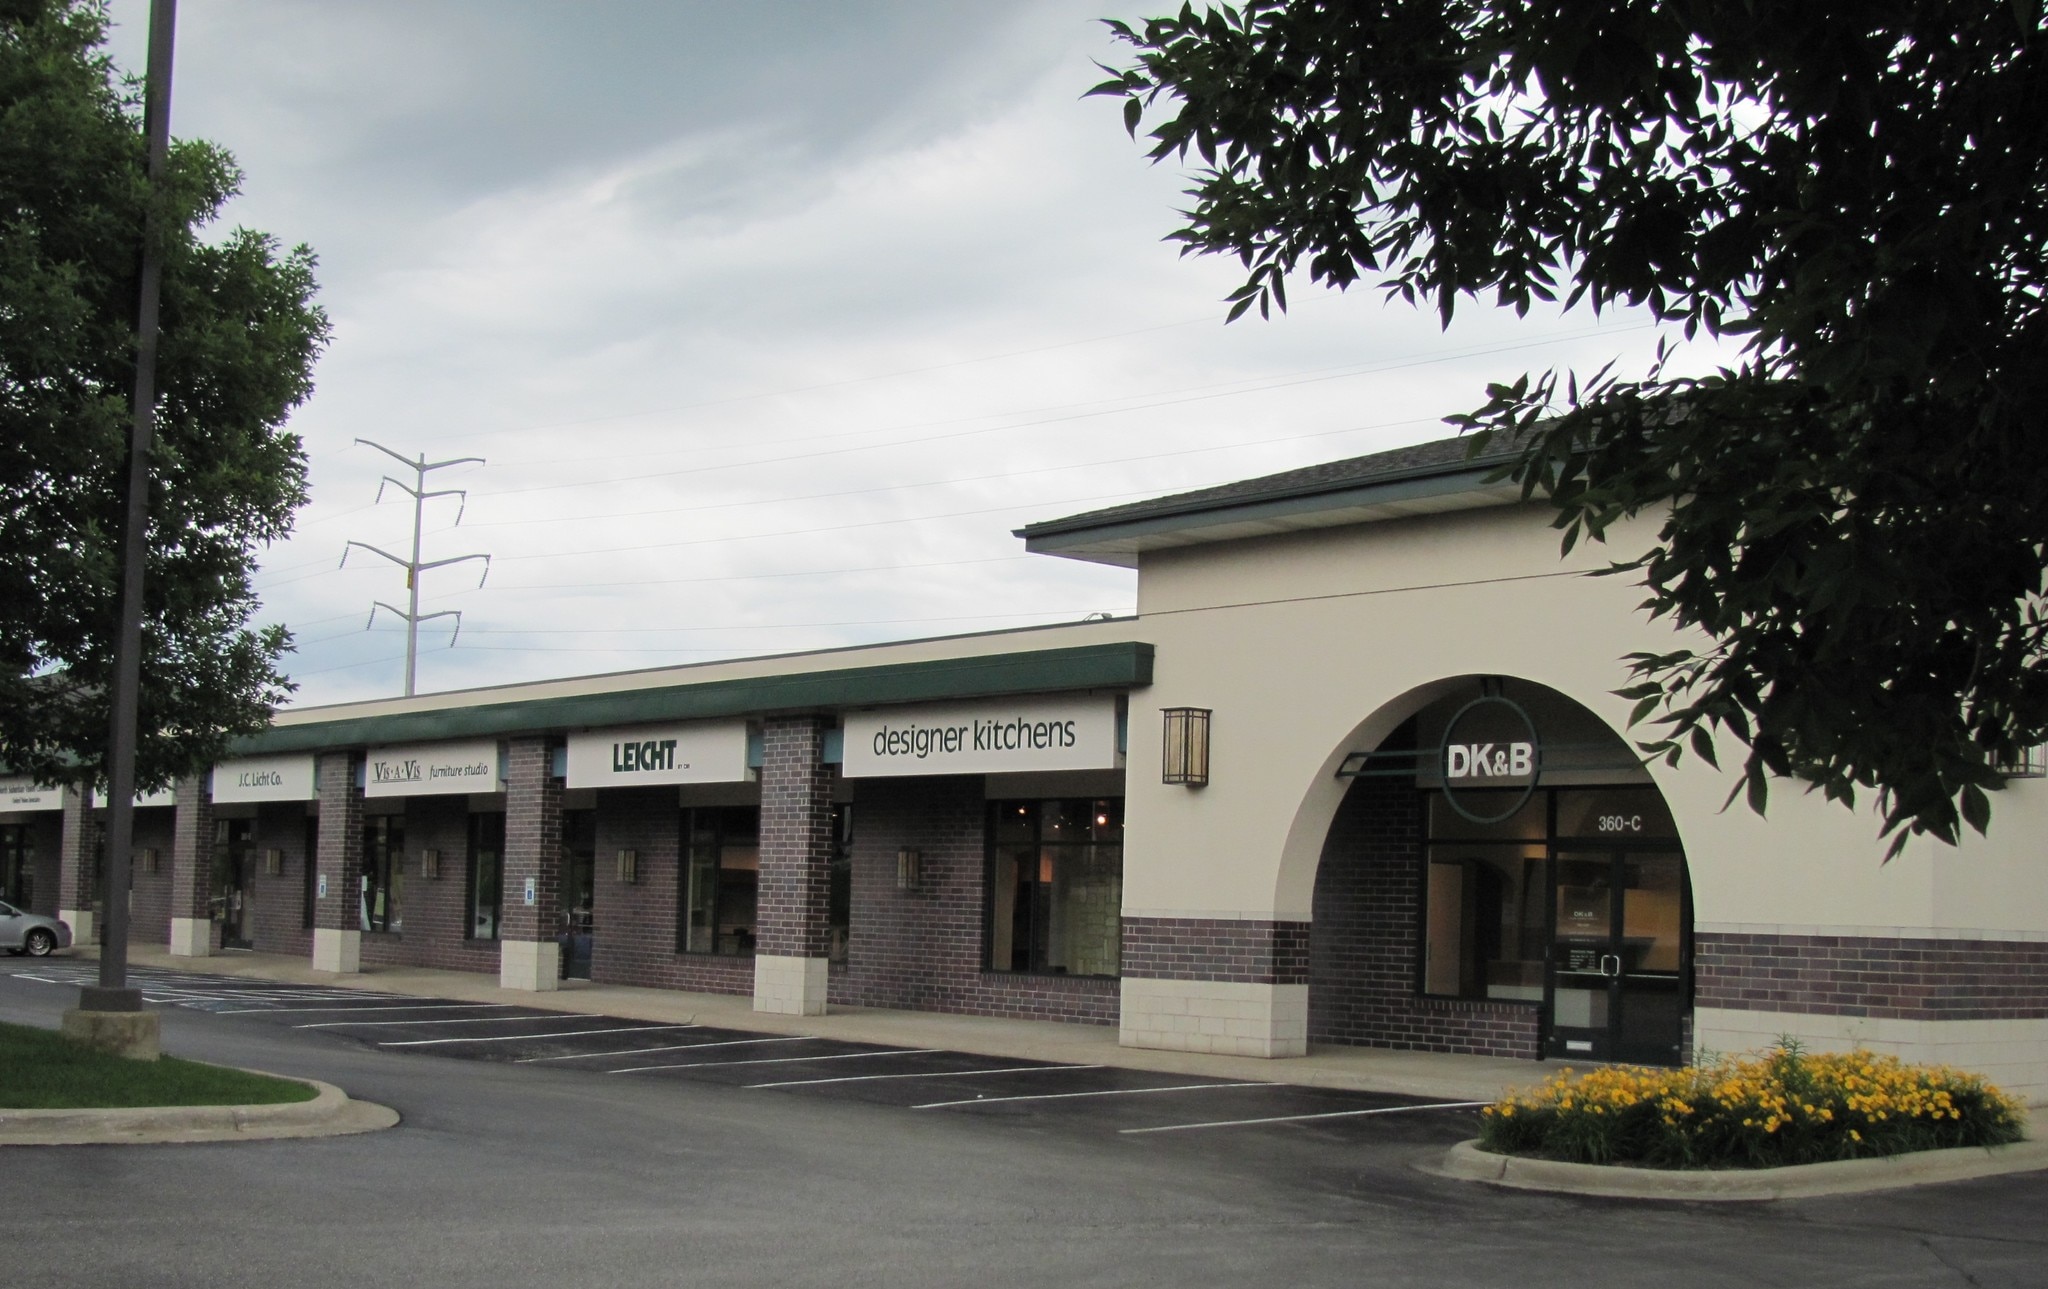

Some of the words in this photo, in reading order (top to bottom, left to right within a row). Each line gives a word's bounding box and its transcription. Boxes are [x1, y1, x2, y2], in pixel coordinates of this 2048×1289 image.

[873, 725, 968, 759] designer
[973, 717, 1076, 751] kitchens
[613, 740, 677, 772] LEICHT
[1448, 742, 1532, 778] DK&B
[252, 771, 269, 787] Licht
[271, 771, 282, 786] Co.
[429, 765, 463, 781] furniture
[464, 762, 488, 776] studio
[1598, 815, 1641, 831] 360-C
